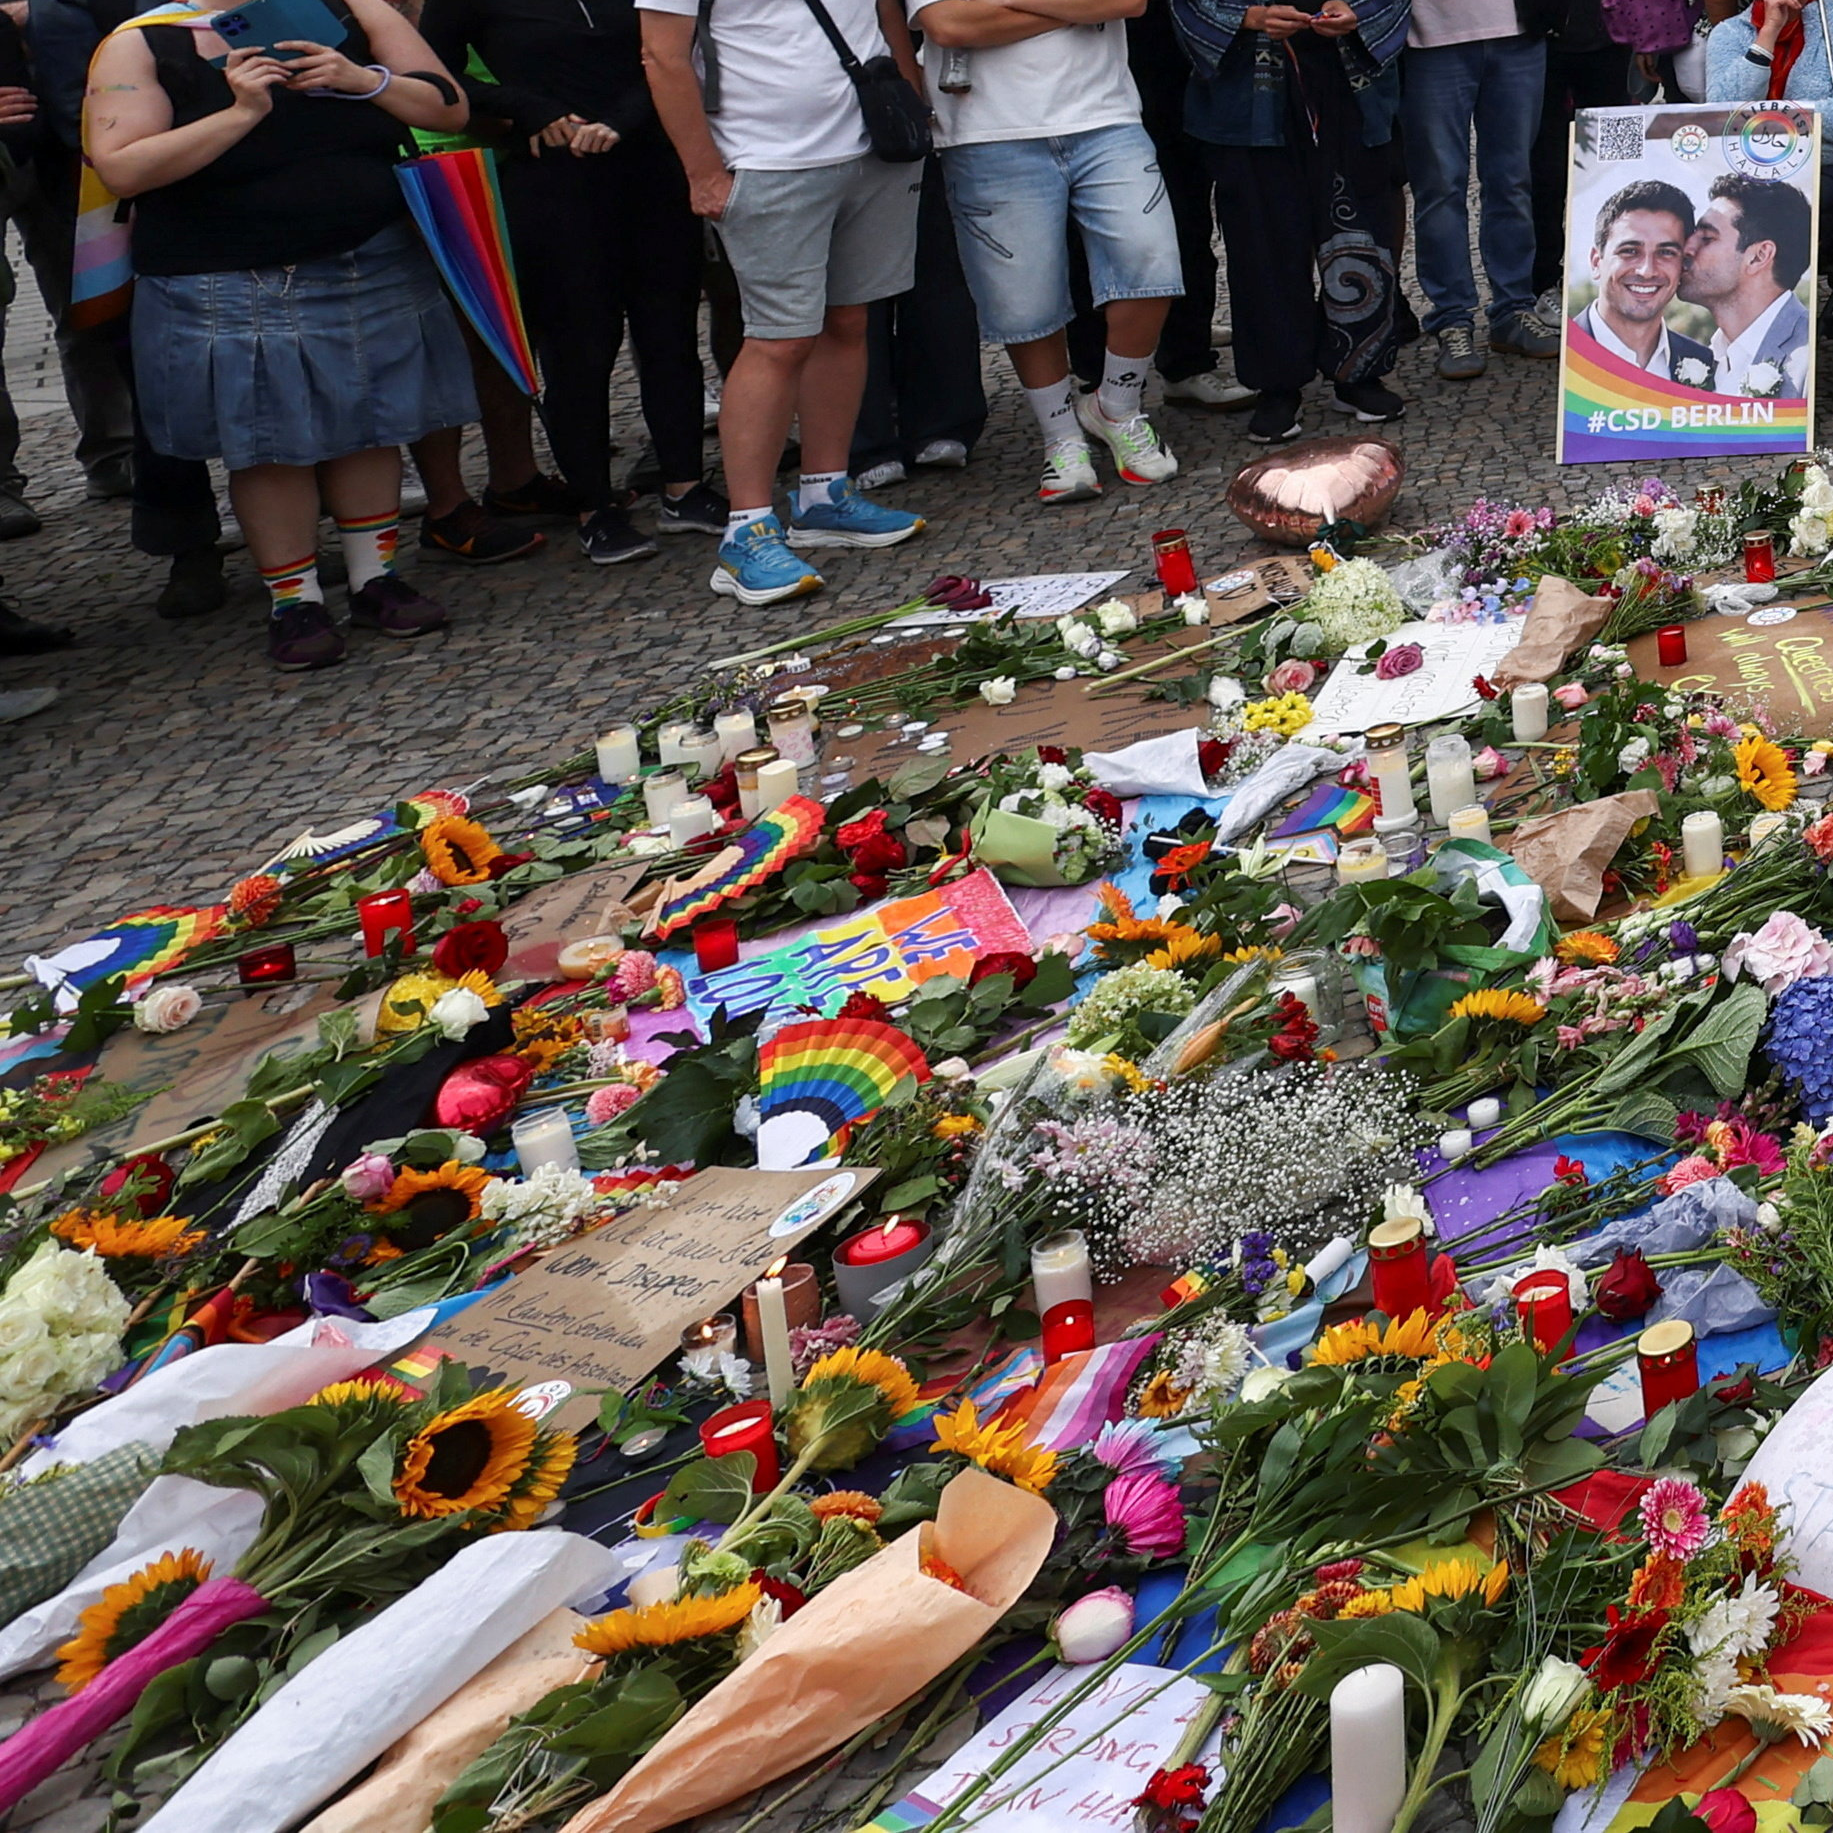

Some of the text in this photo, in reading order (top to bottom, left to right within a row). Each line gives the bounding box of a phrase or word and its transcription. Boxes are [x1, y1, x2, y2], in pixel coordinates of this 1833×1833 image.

[1587, 401, 1775, 433] #CSD BERLIN
[1726, 652, 1774, 695] always
[888, 906, 980, 966] WE
[790, 931, 902, 1007] ARE
[459, 1327, 490, 1348] die
